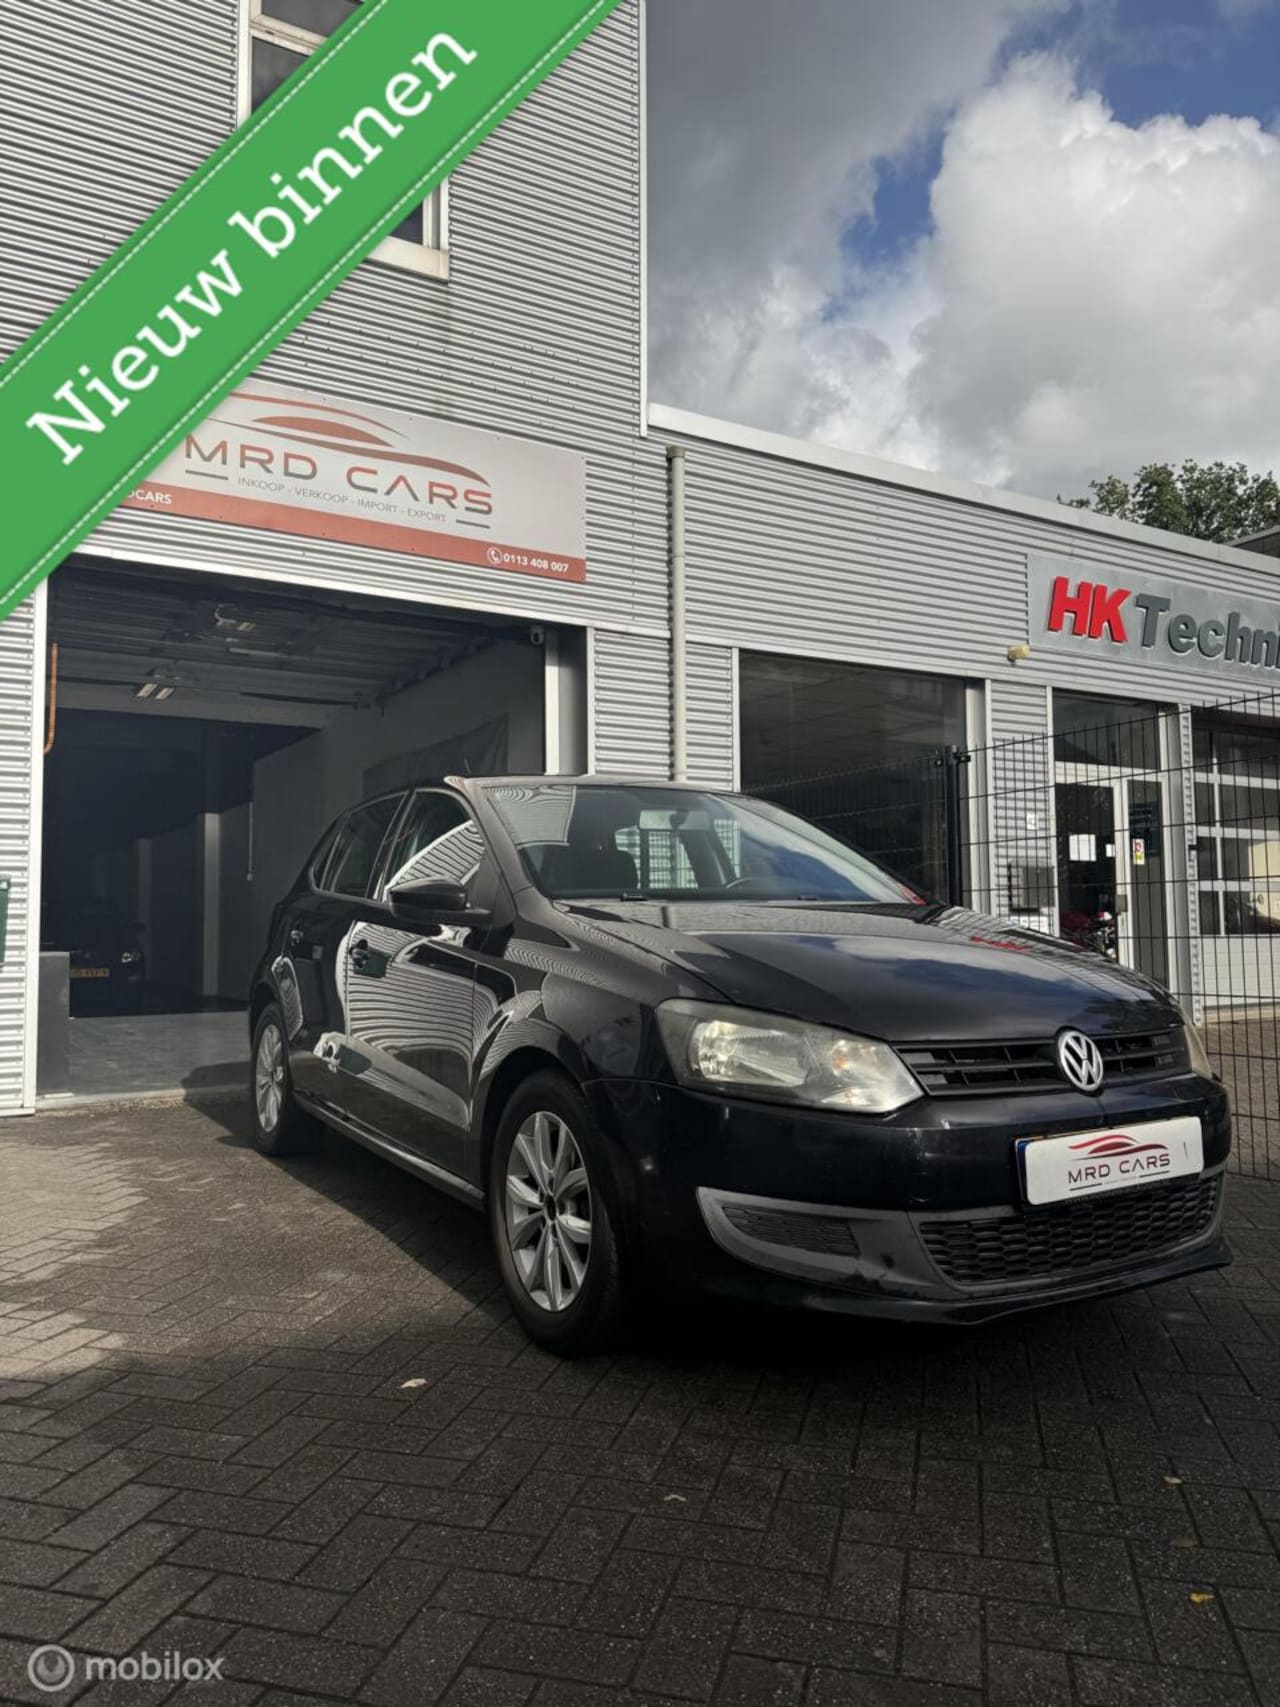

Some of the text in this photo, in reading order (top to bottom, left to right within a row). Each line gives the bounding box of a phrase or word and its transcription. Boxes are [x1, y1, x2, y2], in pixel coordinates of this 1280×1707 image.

[184, 433, 493, 516] MRD CARS
[237, 476, 448, 523] INKOOP VERKOOP IMPORT EXPORT
[502, 553, 570, 574] 0113 408 007
[1047, 576, 1132, 643] HK
[1067, 1163, 1110, 1184] MRD
[1119, 1153, 1170, 1174] CARS
